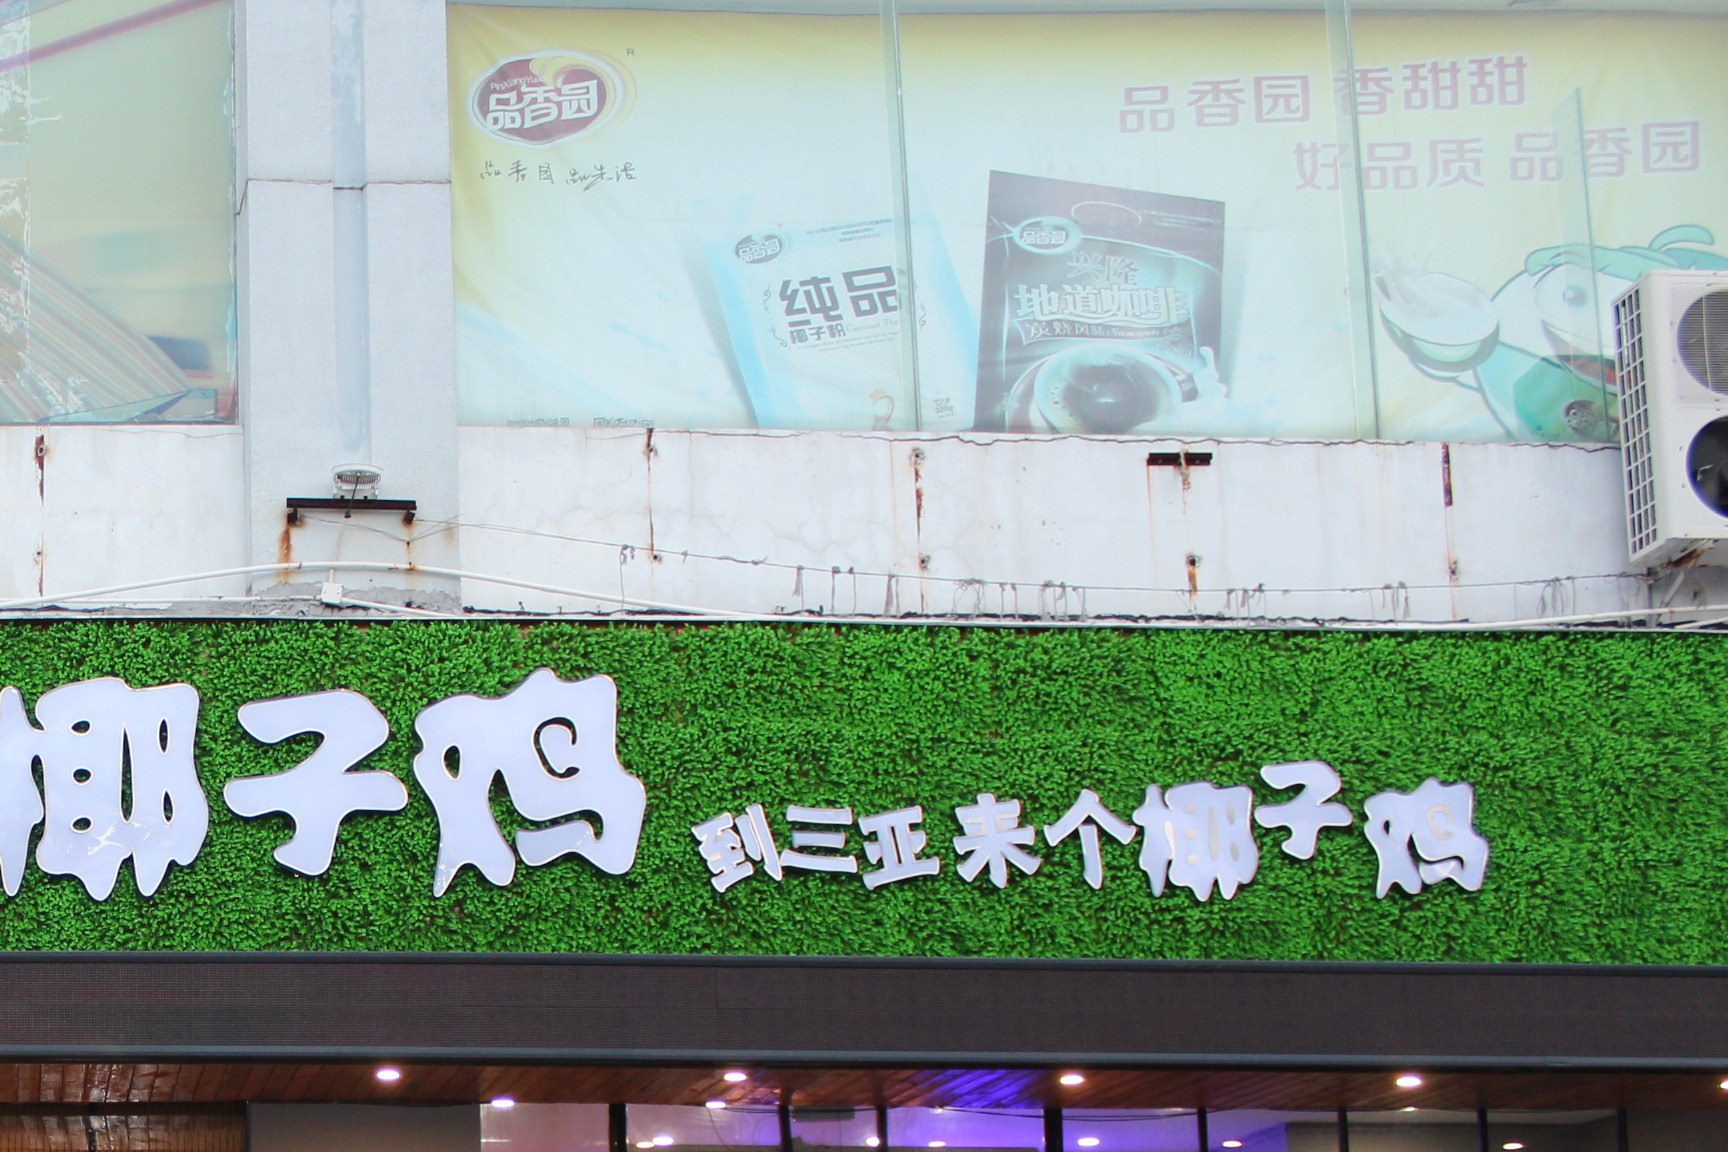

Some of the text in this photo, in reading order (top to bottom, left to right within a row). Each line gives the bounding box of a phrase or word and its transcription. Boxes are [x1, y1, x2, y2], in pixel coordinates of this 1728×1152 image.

[486, 79, 599, 131] 品香园
[1119, 54, 1528, 133] 品香园 香甜甜
[1293, 120, 1701, 192] 好品质 品香园
[779, 265, 899, 327] 纯品
[1067, 251, 1139, 285] 兴隆
[1013, 284, 1191, 328] 地道咖啡
[690, 760, 1491, 902] 到三亚来个椰子鸡
